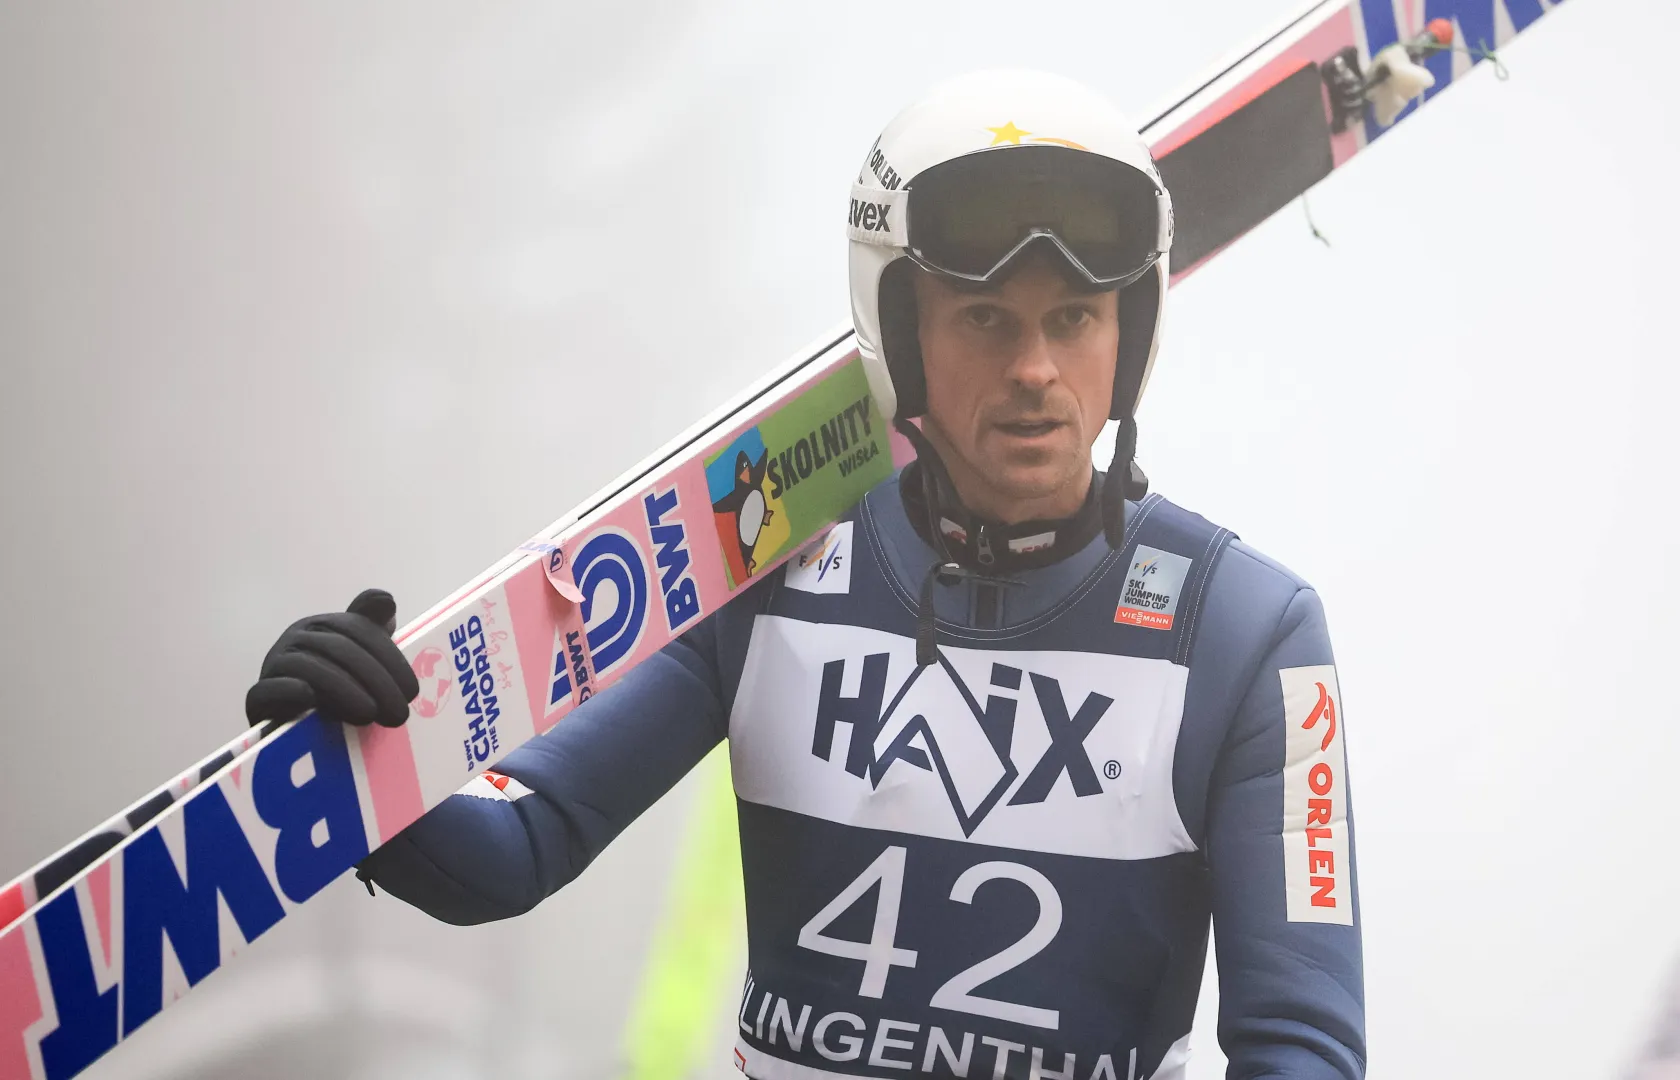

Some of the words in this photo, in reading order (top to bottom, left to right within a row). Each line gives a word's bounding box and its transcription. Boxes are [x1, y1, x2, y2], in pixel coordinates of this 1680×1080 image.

[870, 149, 902, 191] ORLEN
[766, 395, 874, 500] SKOLNITY
[644, 487, 700, 632] BWT
[1124, 596, 1150, 608] WORLD
[1151, 602, 1167, 611] CUP
[1125, 588, 1170, 604] JUMPING
[1128, 579, 1145, 590] SKI
[449, 624, 491, 763] CHANGE
[467, 615, 501, 727] WORLD
[566, 630, 589, 687] BWT
[489, 725, 500, 754] THE
[1305, 762, 1337, 909] ORLEN
[34, 711, 370, 1080] BWT
[797, 845, 1063, 1031] 42
